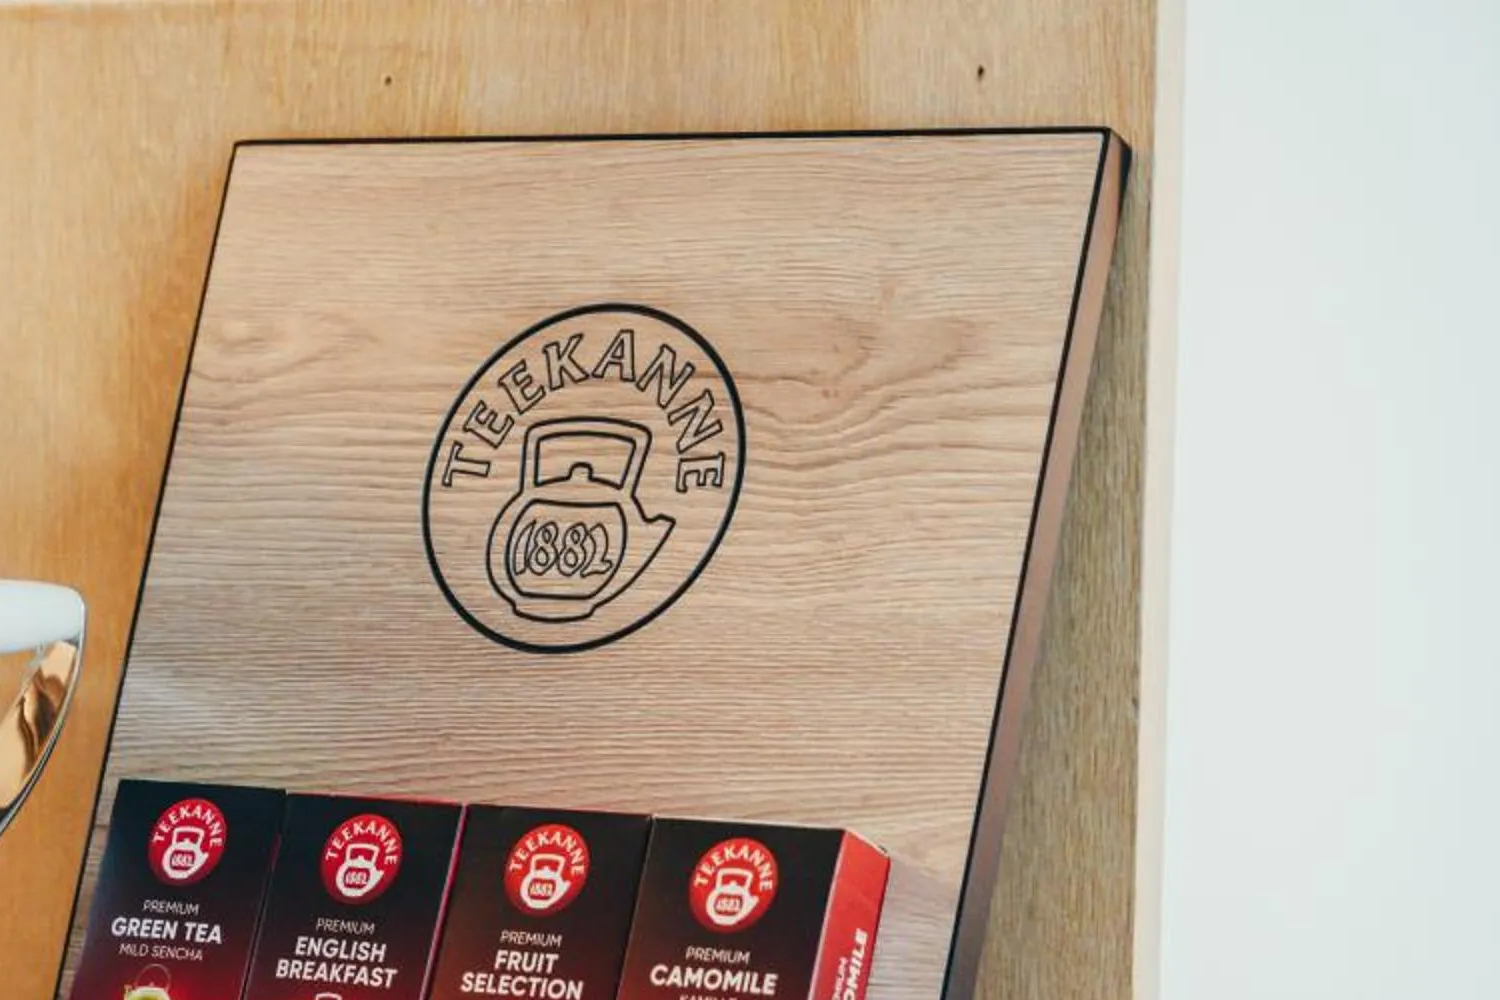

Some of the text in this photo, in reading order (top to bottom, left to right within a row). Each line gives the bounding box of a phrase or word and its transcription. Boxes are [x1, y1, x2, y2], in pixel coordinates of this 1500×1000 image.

[442, 329, 725, 493] TEEKANNE
[512, 519, 613, 578] 1882
[152, 804, 223, 848] TEEKANNE
[325, 820, 398, 865] TEEKANNE
[509, 831, 585, 876] TEEKANNE
[694, 844, 773, 891] TEEKANNE
[142, 899, 200, 916] PREMIUM
[111, 916, 222, 945] GREEN TEA
[315, 917, 375, 935] PREMIUM
[500, 930, 562, 947] PREMIUM
[119, 943, 203, 961] MILD SENCHA
[295, 935, 387, 963] ENGLISH
[494, 949, 559, 974] FRUIT
[685, 946, 750, 965] PREMIUM
[275, 959, 397, 989] BREAKFAST
[650, 963, 778, 996] CAMOMILE
